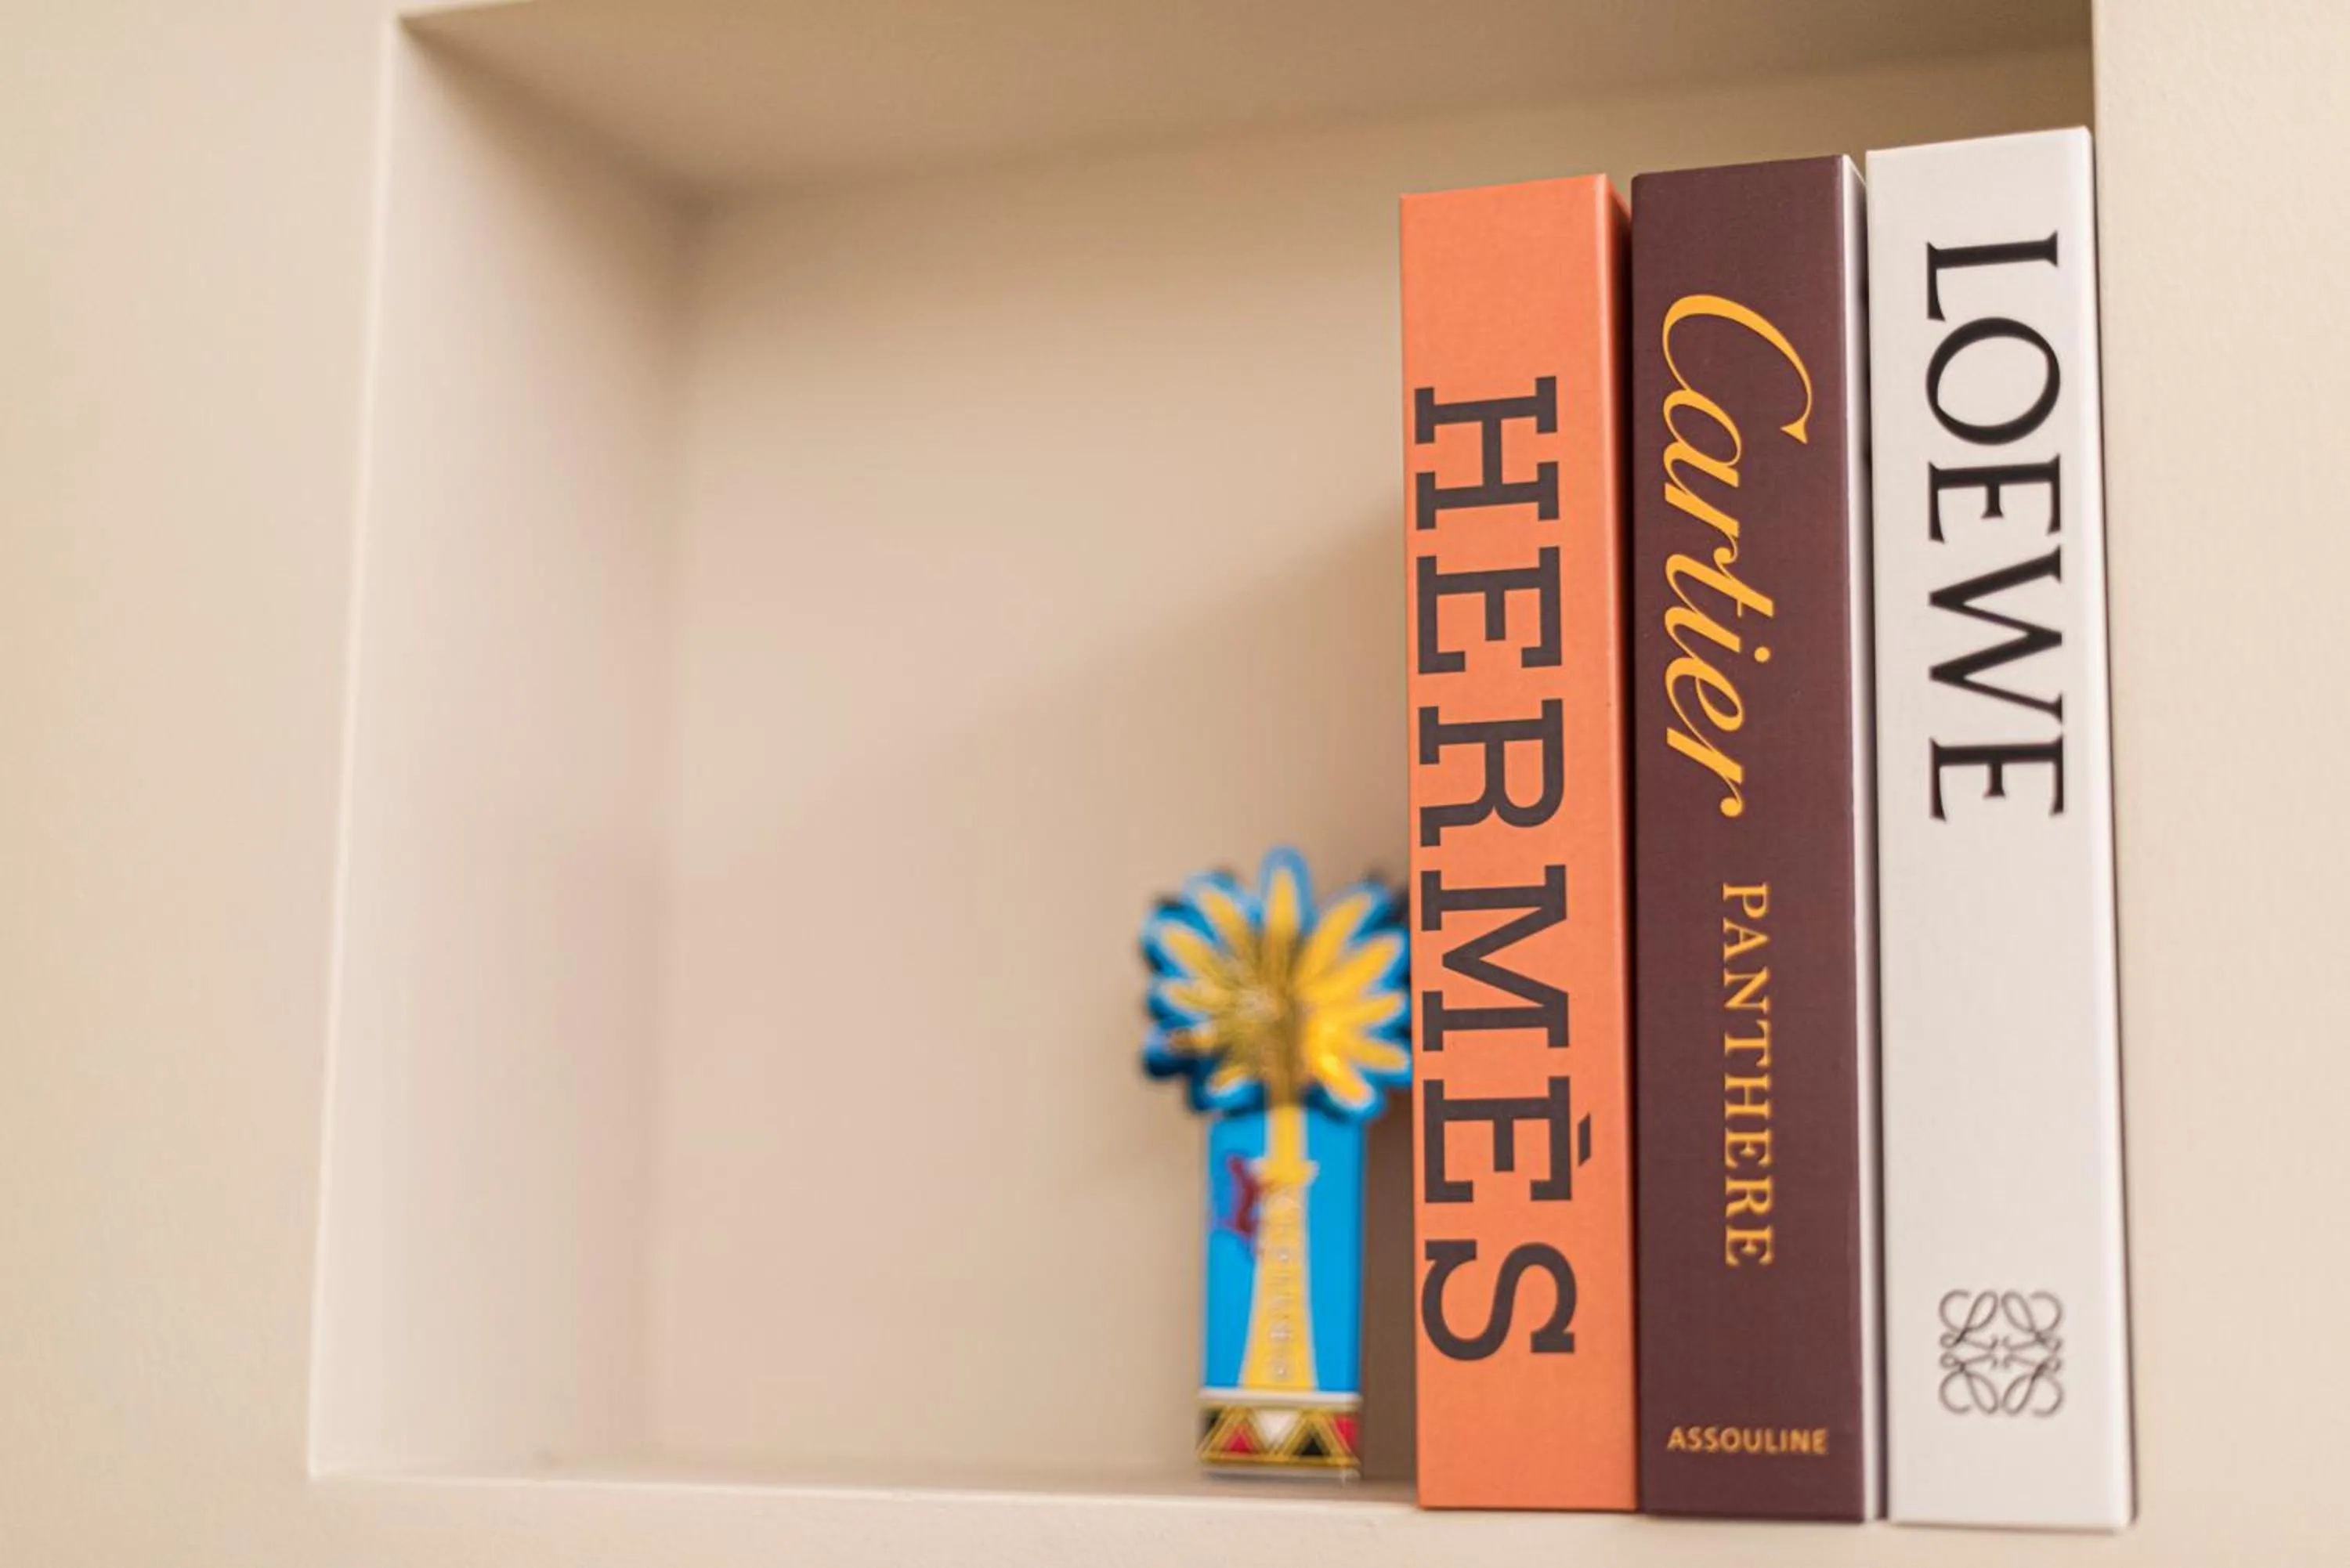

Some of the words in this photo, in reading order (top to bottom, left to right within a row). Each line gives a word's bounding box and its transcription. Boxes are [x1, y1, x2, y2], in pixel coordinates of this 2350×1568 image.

[1661, 293, 1813, 819] Cartier
[1925, 231, 2066, 822] LOEWE
[1414, 376, 1592, 1361] HERMÈS
[1720, 882, 1775, 1268] PANTHERE
[1666, 1425, 1828, 1455] ASSOULINE
